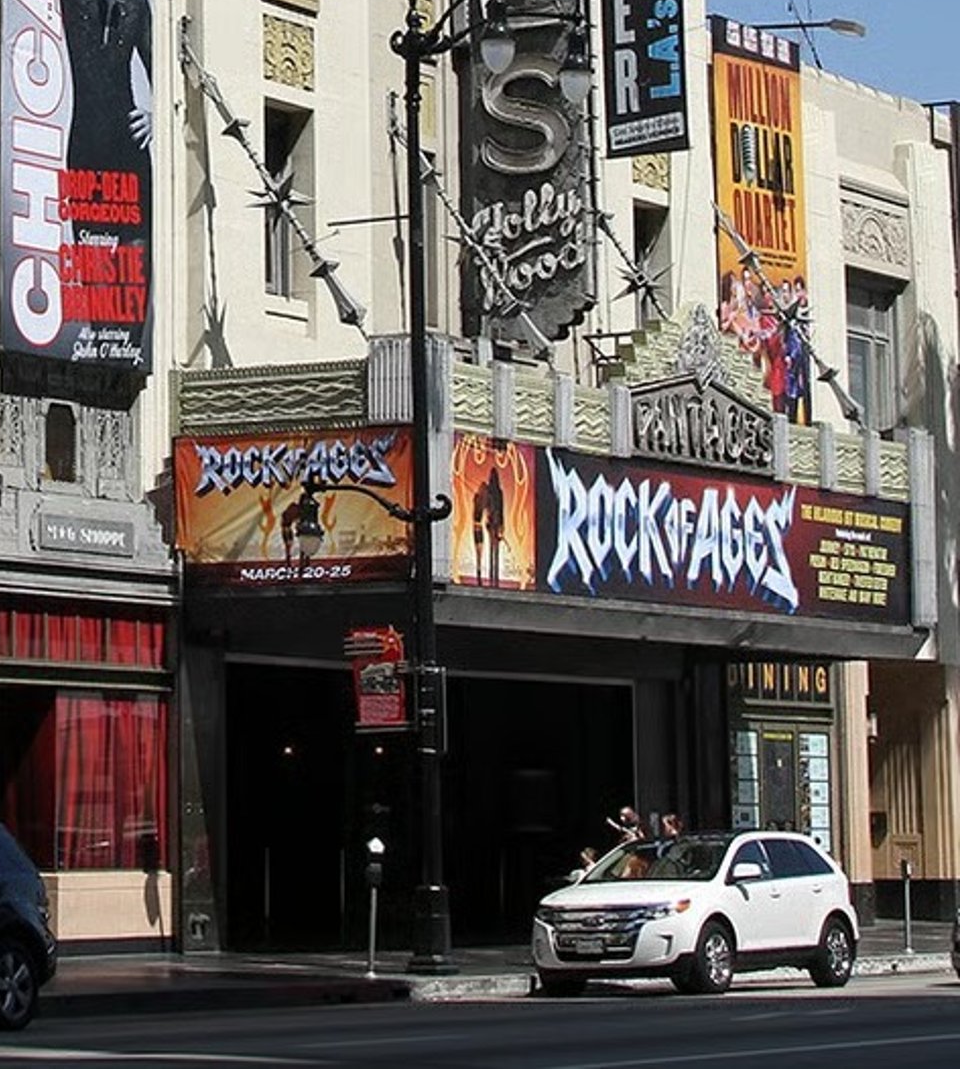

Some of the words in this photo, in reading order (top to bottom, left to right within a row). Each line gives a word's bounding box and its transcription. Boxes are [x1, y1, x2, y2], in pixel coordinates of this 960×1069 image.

[58, 200, 142, 224] GORGEOUS
[78, 229, 120, 254] Starring
[58, 242, 145, 284] CHRISTIE
[62, 283, 147, 323] BRINKLEY
[632, 393, 773, 468] PANTAGES
[191, 438, 290, 498] ROCK
[300, 429, 399, 488] AGES
[545, 445, 676, 598] ROCK
[664, 496, 698, 564] OF
[687, 475, 801, 616] AGES
[240, 566, 300, 582] MARCH
[301, 563, 353, 580] 20-25
[728, 662, 828, 694] DINING
